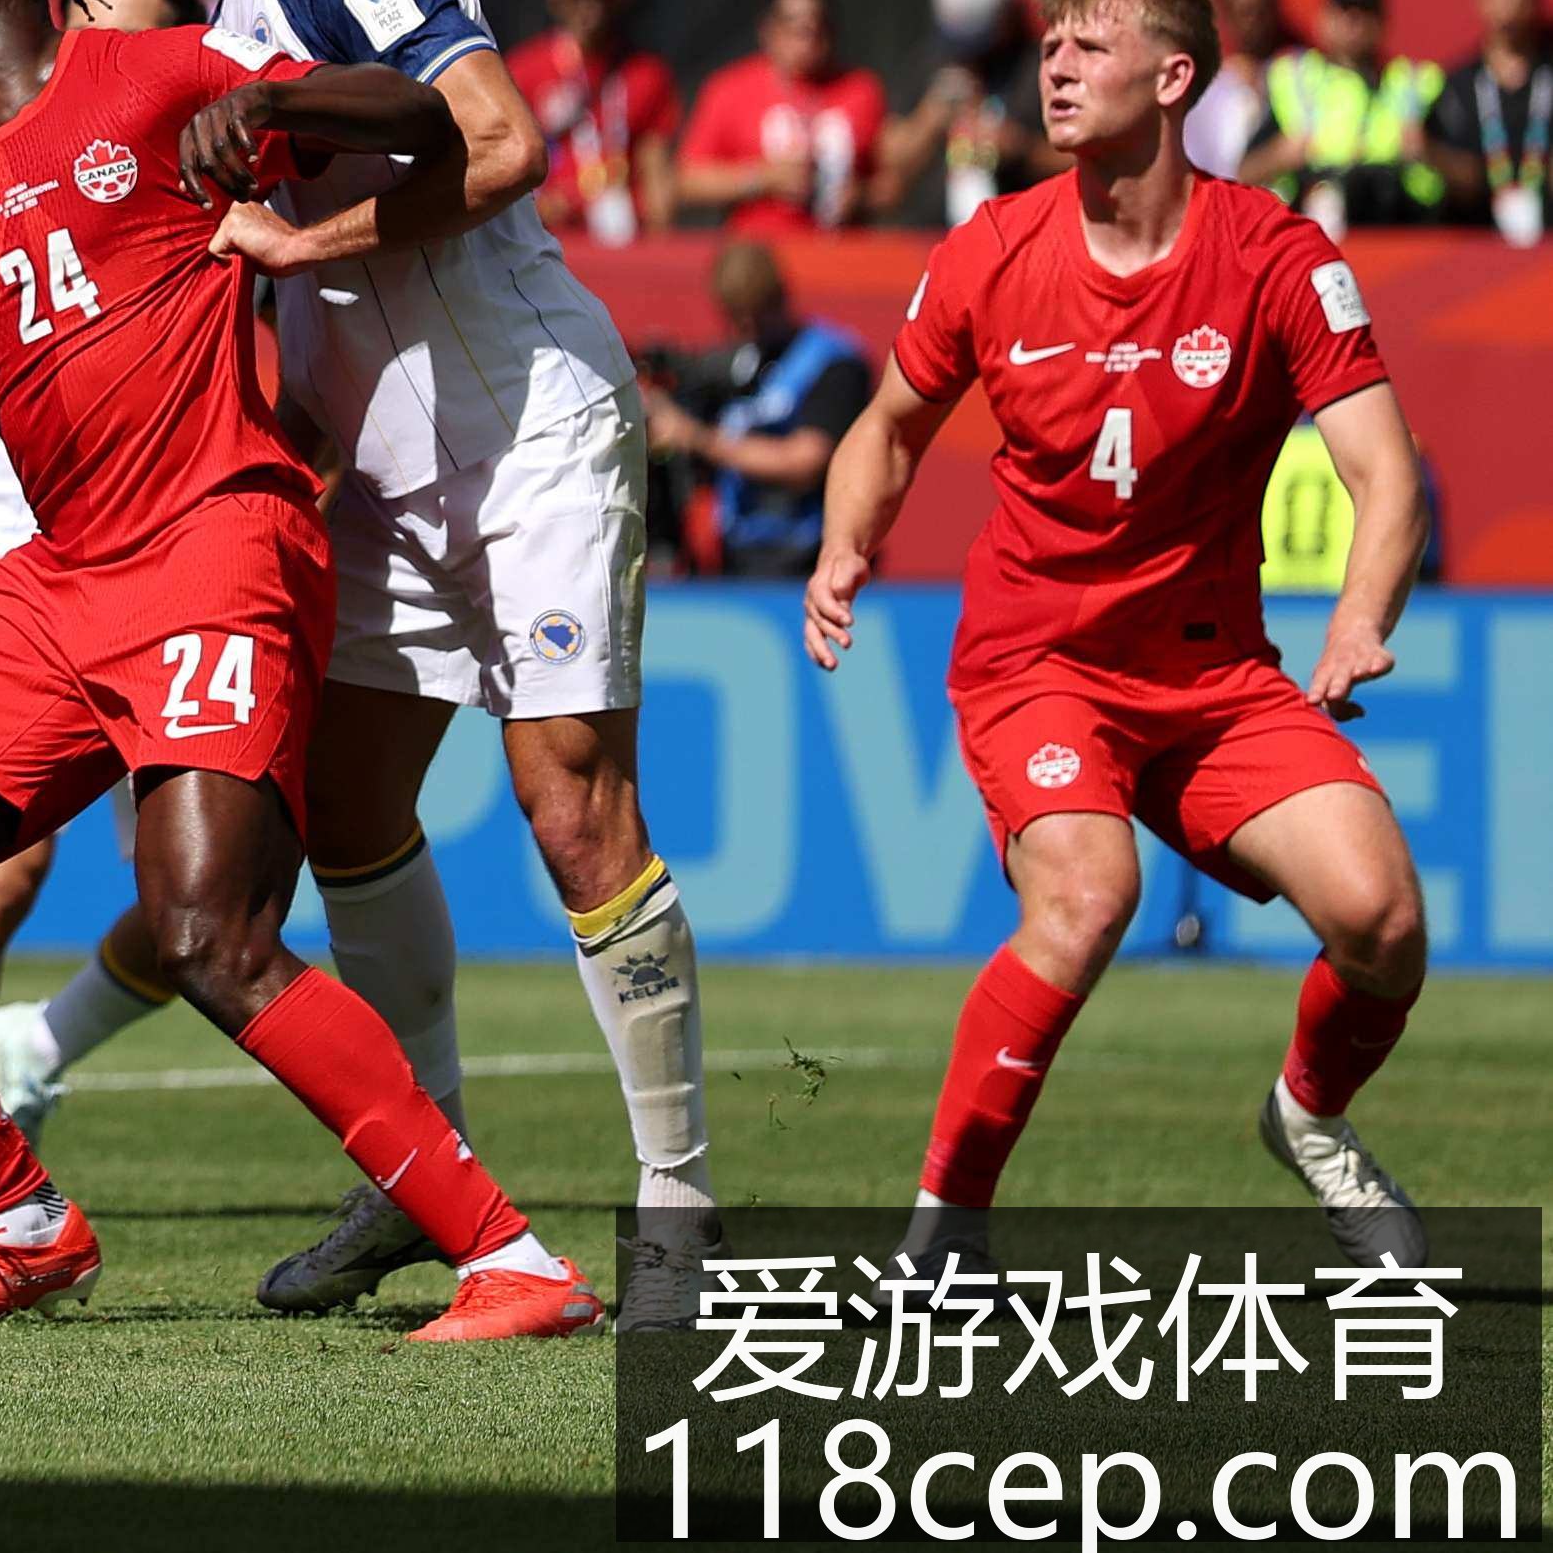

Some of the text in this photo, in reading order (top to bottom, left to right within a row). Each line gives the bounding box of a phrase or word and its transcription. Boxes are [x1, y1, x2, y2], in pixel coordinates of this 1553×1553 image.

[77, 160, 136, 184] CANADA
[1089, 406, 1139, 500] 4
[160, 631, 257, 725] 24
[619, 976, 680, 1004] KELME
